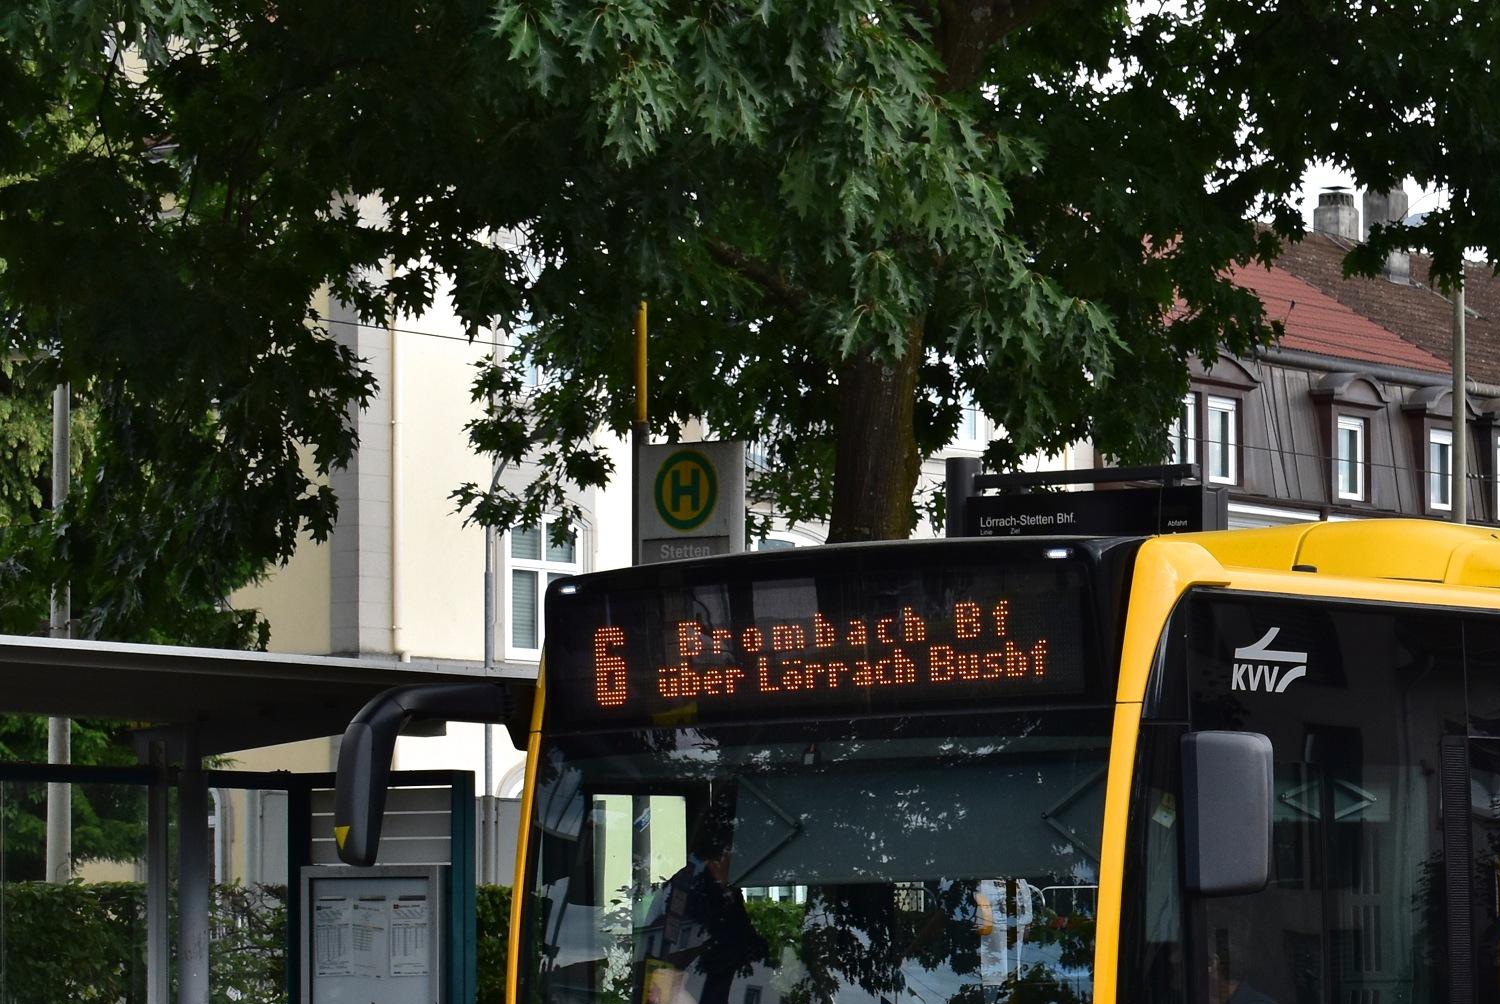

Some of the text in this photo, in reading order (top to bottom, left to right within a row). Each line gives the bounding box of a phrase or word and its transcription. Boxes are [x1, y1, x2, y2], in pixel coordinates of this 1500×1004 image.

[671, 469, 700, 512] H
[979, 512, 1076, 528] Lörrach-Stetten Bhf.
[1167, 519, 1188, 527] Abfahrt
[660, 543, 711, 559] Stetten
[678, 600, 1009, 656] Brombach Bf
[594, 626, 627, 706] 6
[658, 639, 1047, 697] über Lörrach Busbf
